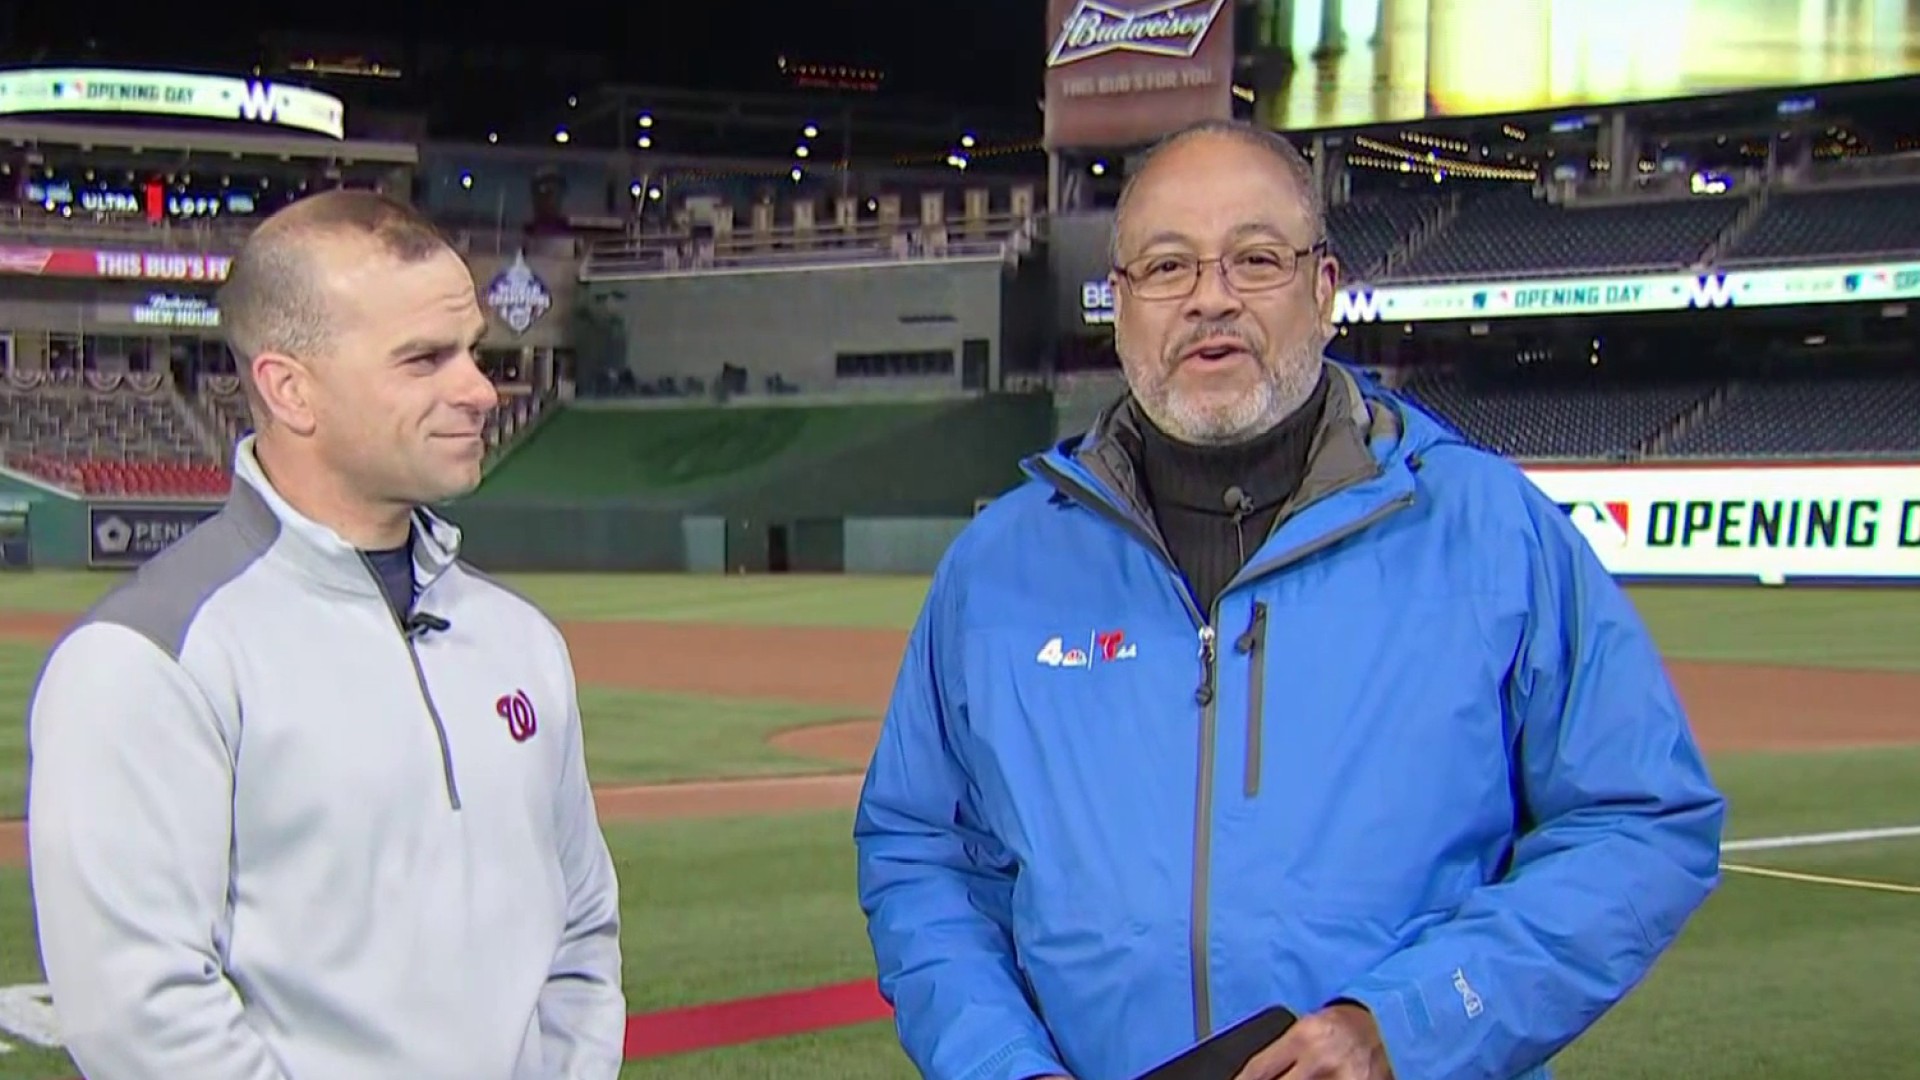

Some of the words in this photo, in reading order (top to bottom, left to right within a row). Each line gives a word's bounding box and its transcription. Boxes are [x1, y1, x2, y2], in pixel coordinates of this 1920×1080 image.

[1066, 10, 1210, 48] Budweiser
[87, 82, 160, 101] OPENING
[165, 86, 195, 103] DAY
[1062, 75, 1096, 96] THIS
[1148, 71, 1177, 90] FOR
[82, 191, 139, 212] ULTRA
[96, 251, 141, 277] THIS
[144, 253, 204, 279] BUD'S
[1514, 288, 1600, 308] OPENING
[1606, 284, 1644, 305] DAY
[1646, 500, 1878, 547] OPENING
[1036, 637, 1063, 667] 4
[496, 689, 537, 743] W
